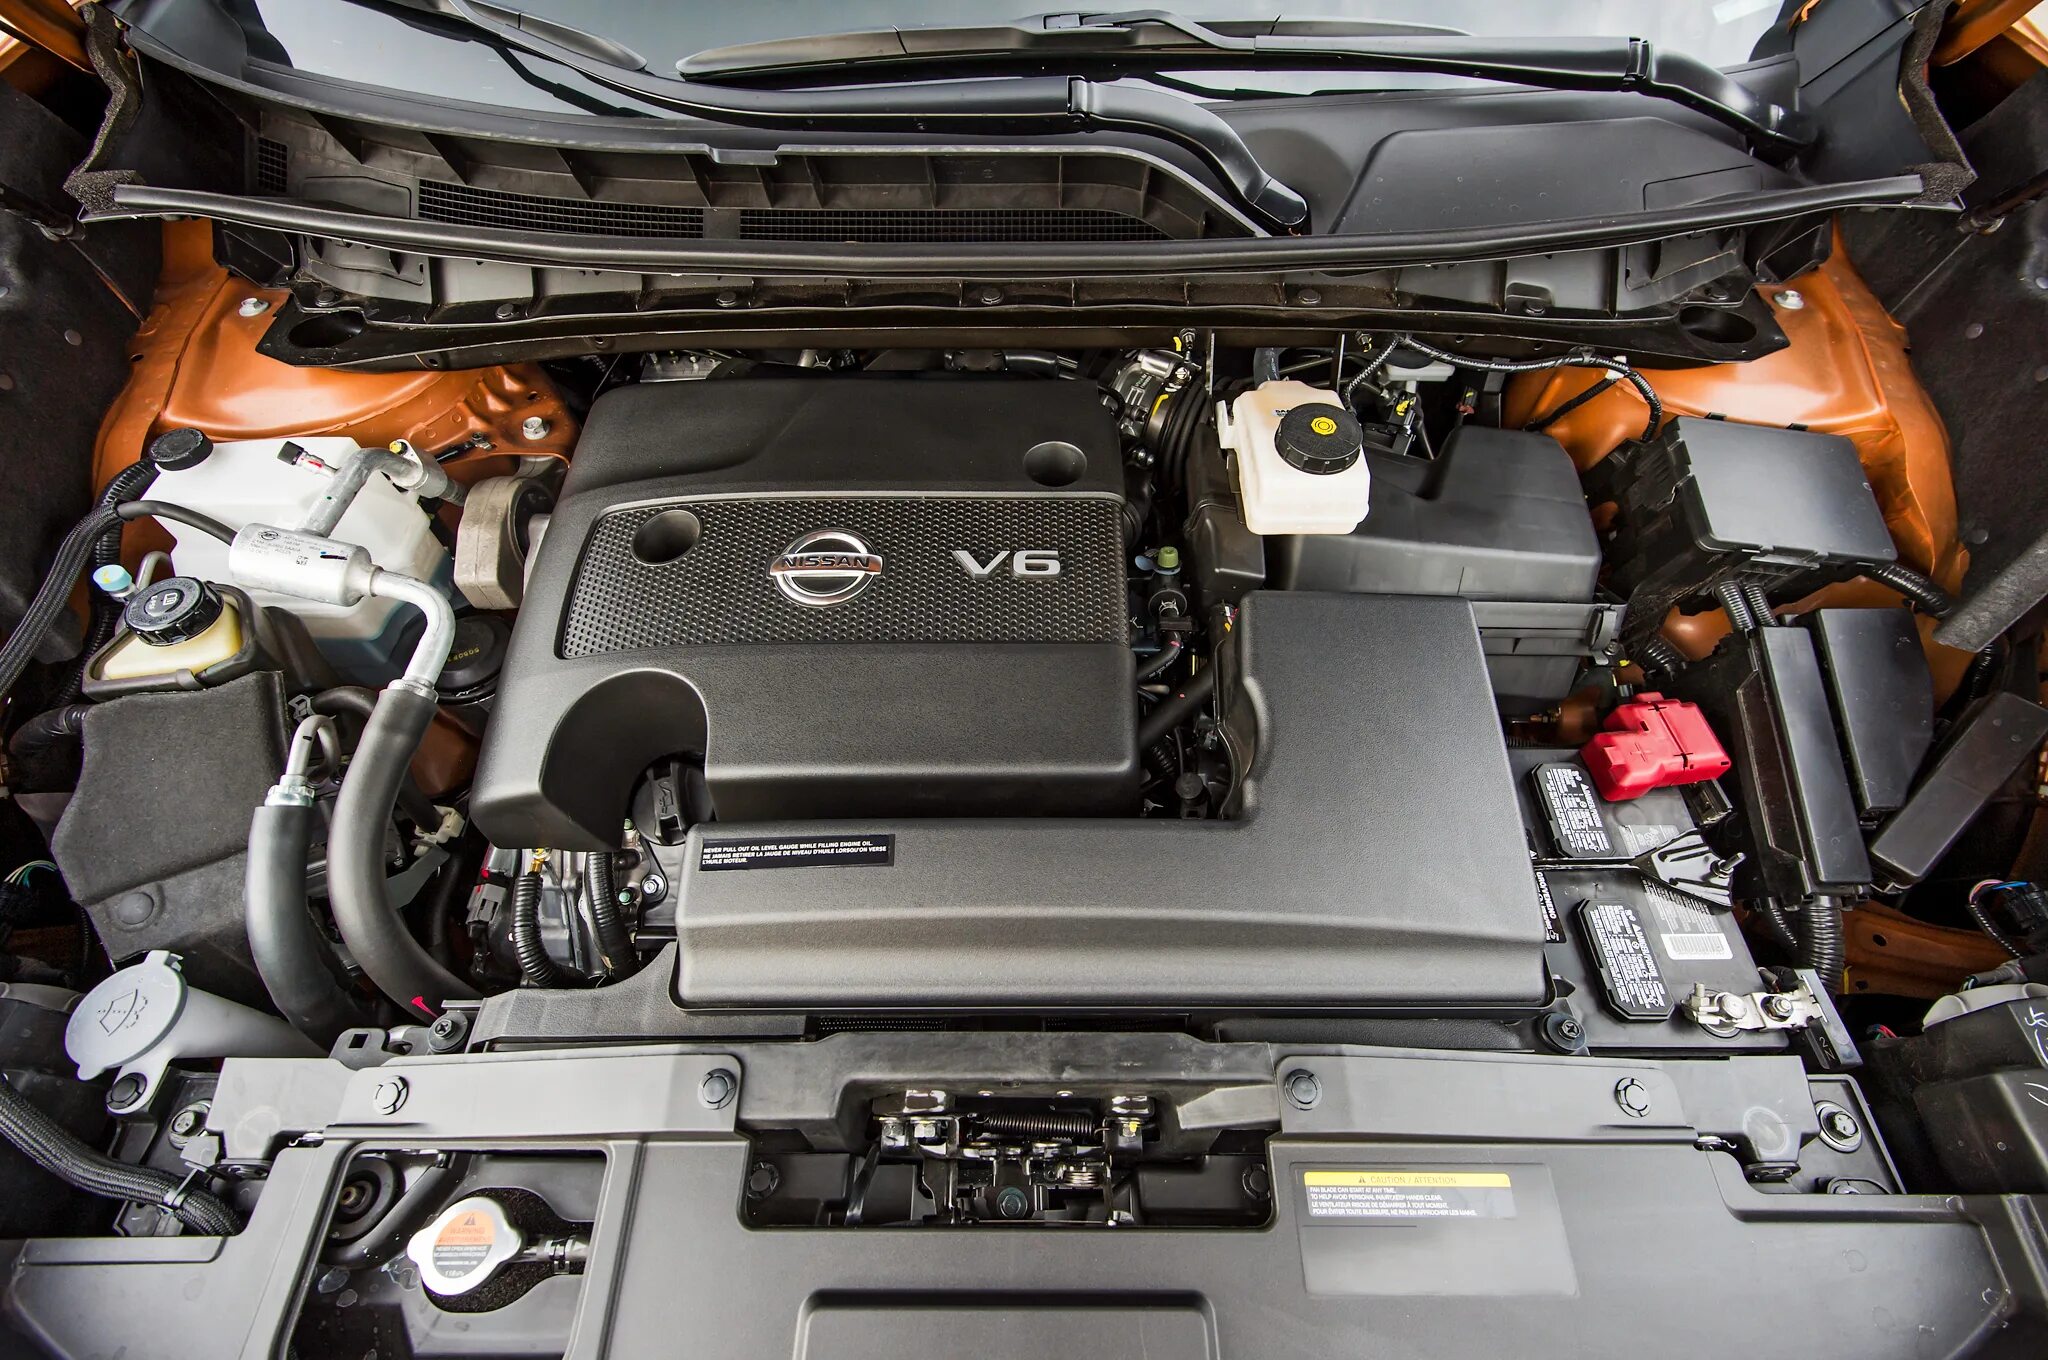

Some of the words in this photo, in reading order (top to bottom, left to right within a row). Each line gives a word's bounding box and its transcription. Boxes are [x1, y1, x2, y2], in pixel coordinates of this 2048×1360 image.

[782, 554, 870, 569] NISSAN
[951, 549, 1061, 579] V6
[1636, 931, 1659, 978] DANGER/POISON
[1370, 1176, 1406, 1184] CAUTION
[1414, 1176, 1457, 1184] ATTENTION
